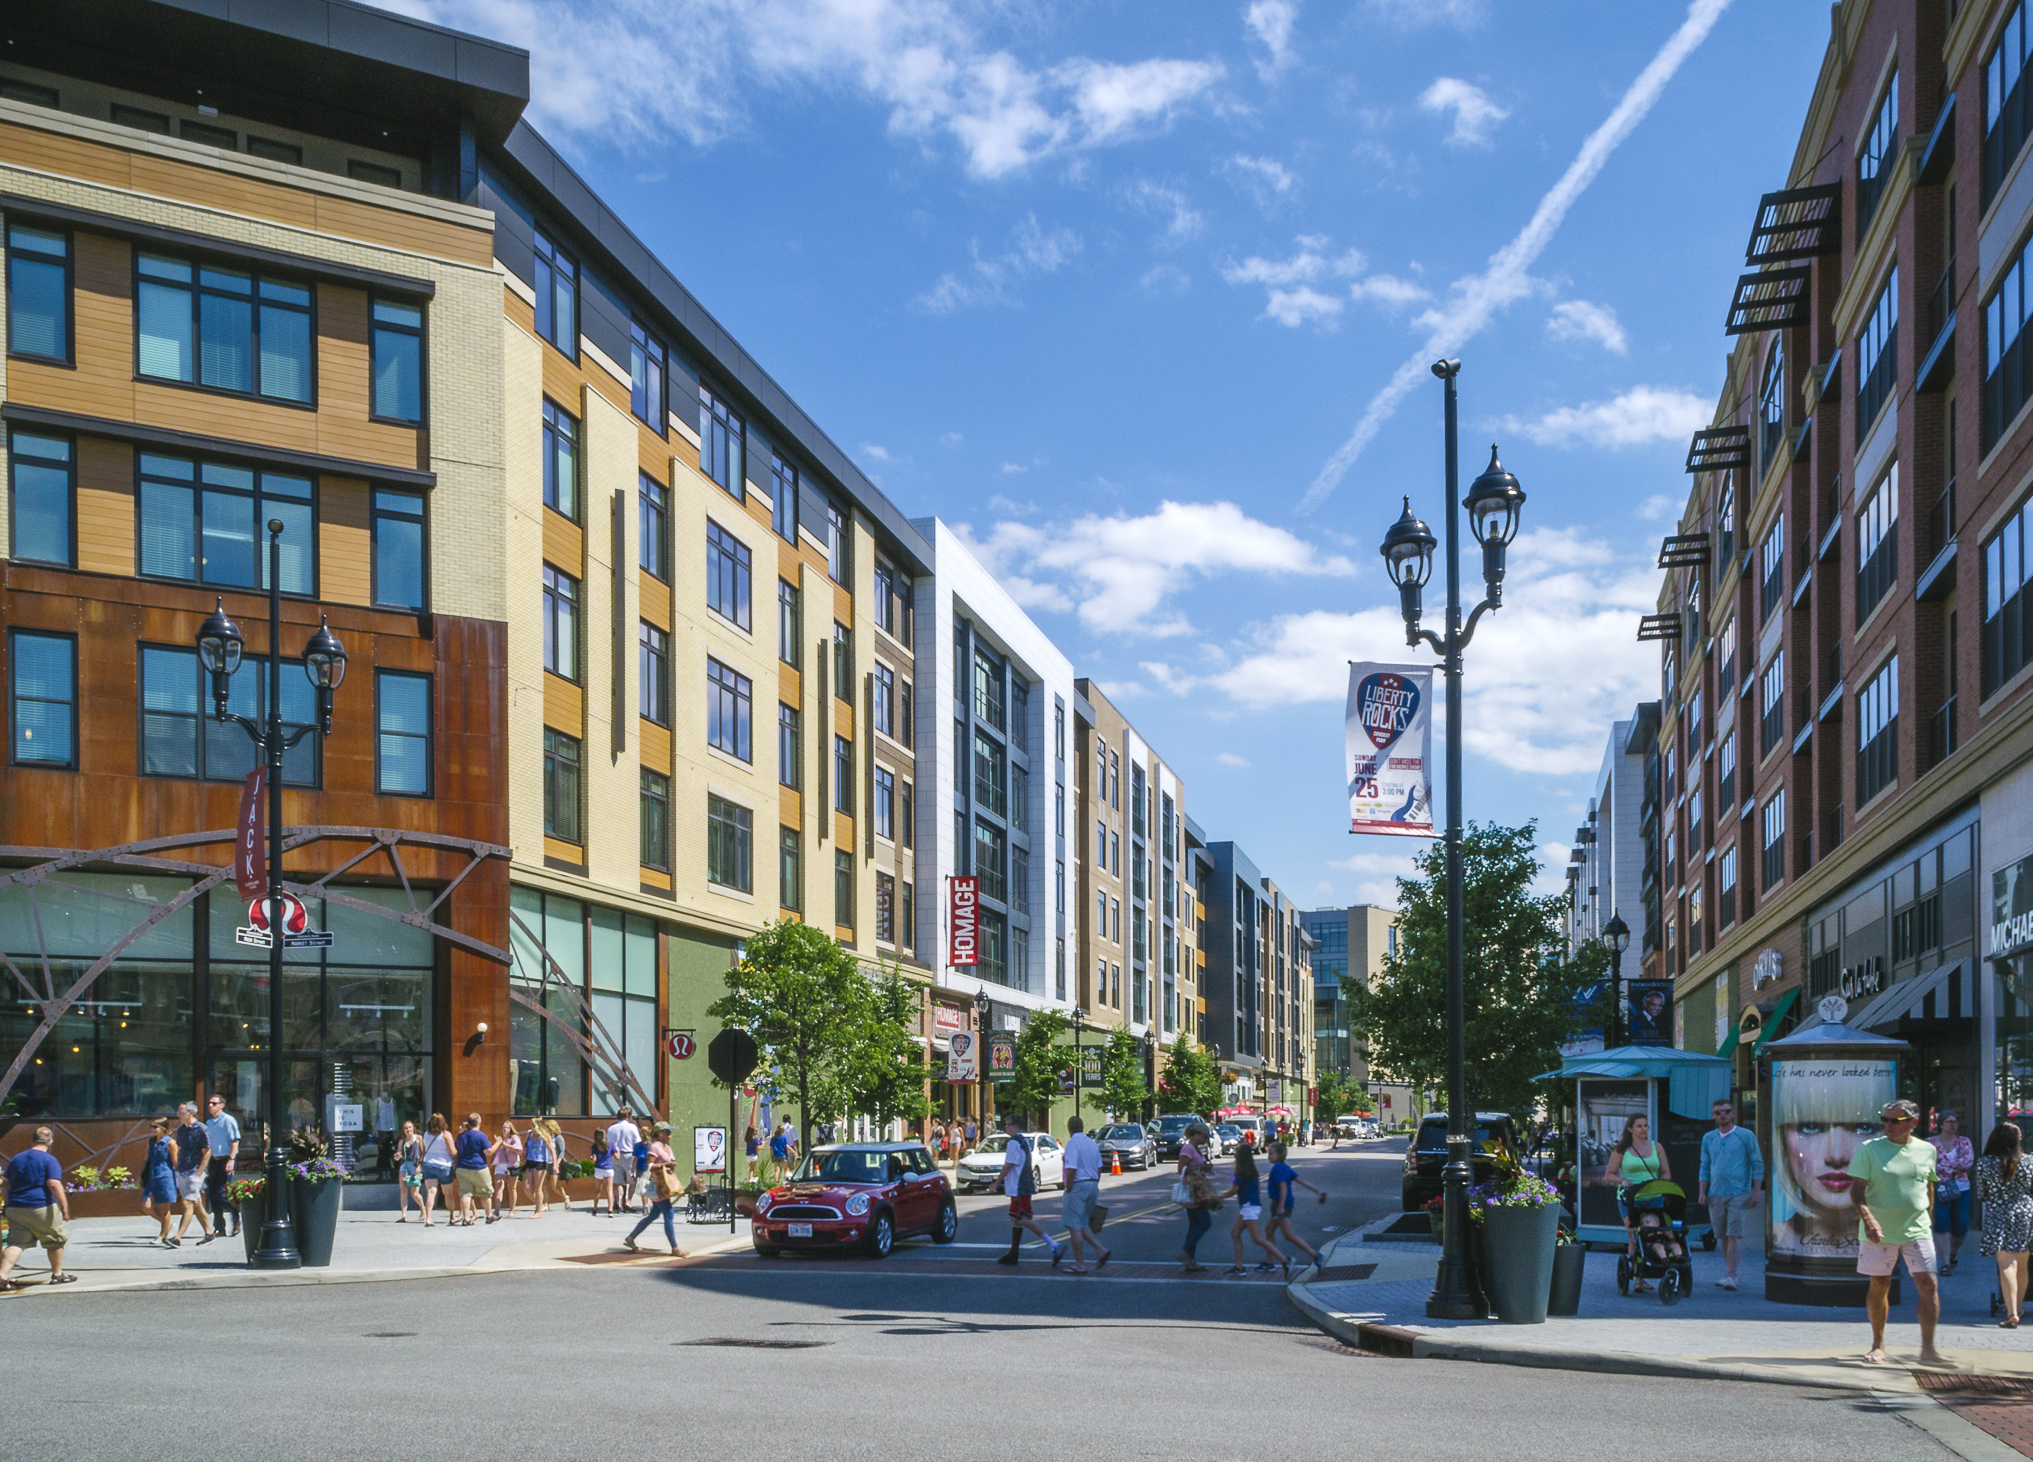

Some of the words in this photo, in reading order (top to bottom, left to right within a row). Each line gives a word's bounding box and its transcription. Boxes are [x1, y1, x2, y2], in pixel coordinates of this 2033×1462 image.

[1365, 685, 1415, 708] LIBERTY
[1361, 701, 1410, 732] ROCKS
[1354, 762, 1378, 775] JUNE
[1354, 777, 1379, 799] 25
[1396, 788, 1405, 796] PM
[953, 879, 975, 964] HOMAGE
[937, 1005, 959, 1025] HOMAGE
[1084, 1060, 1101, 1073] 100
[1790, 1065, 1806, 1077] has
[1809, 1069, 1839, 1077] never
[1842, 1065, 1871, 1077] looked
[1084, 1073, 1101, 1081] YEARS
